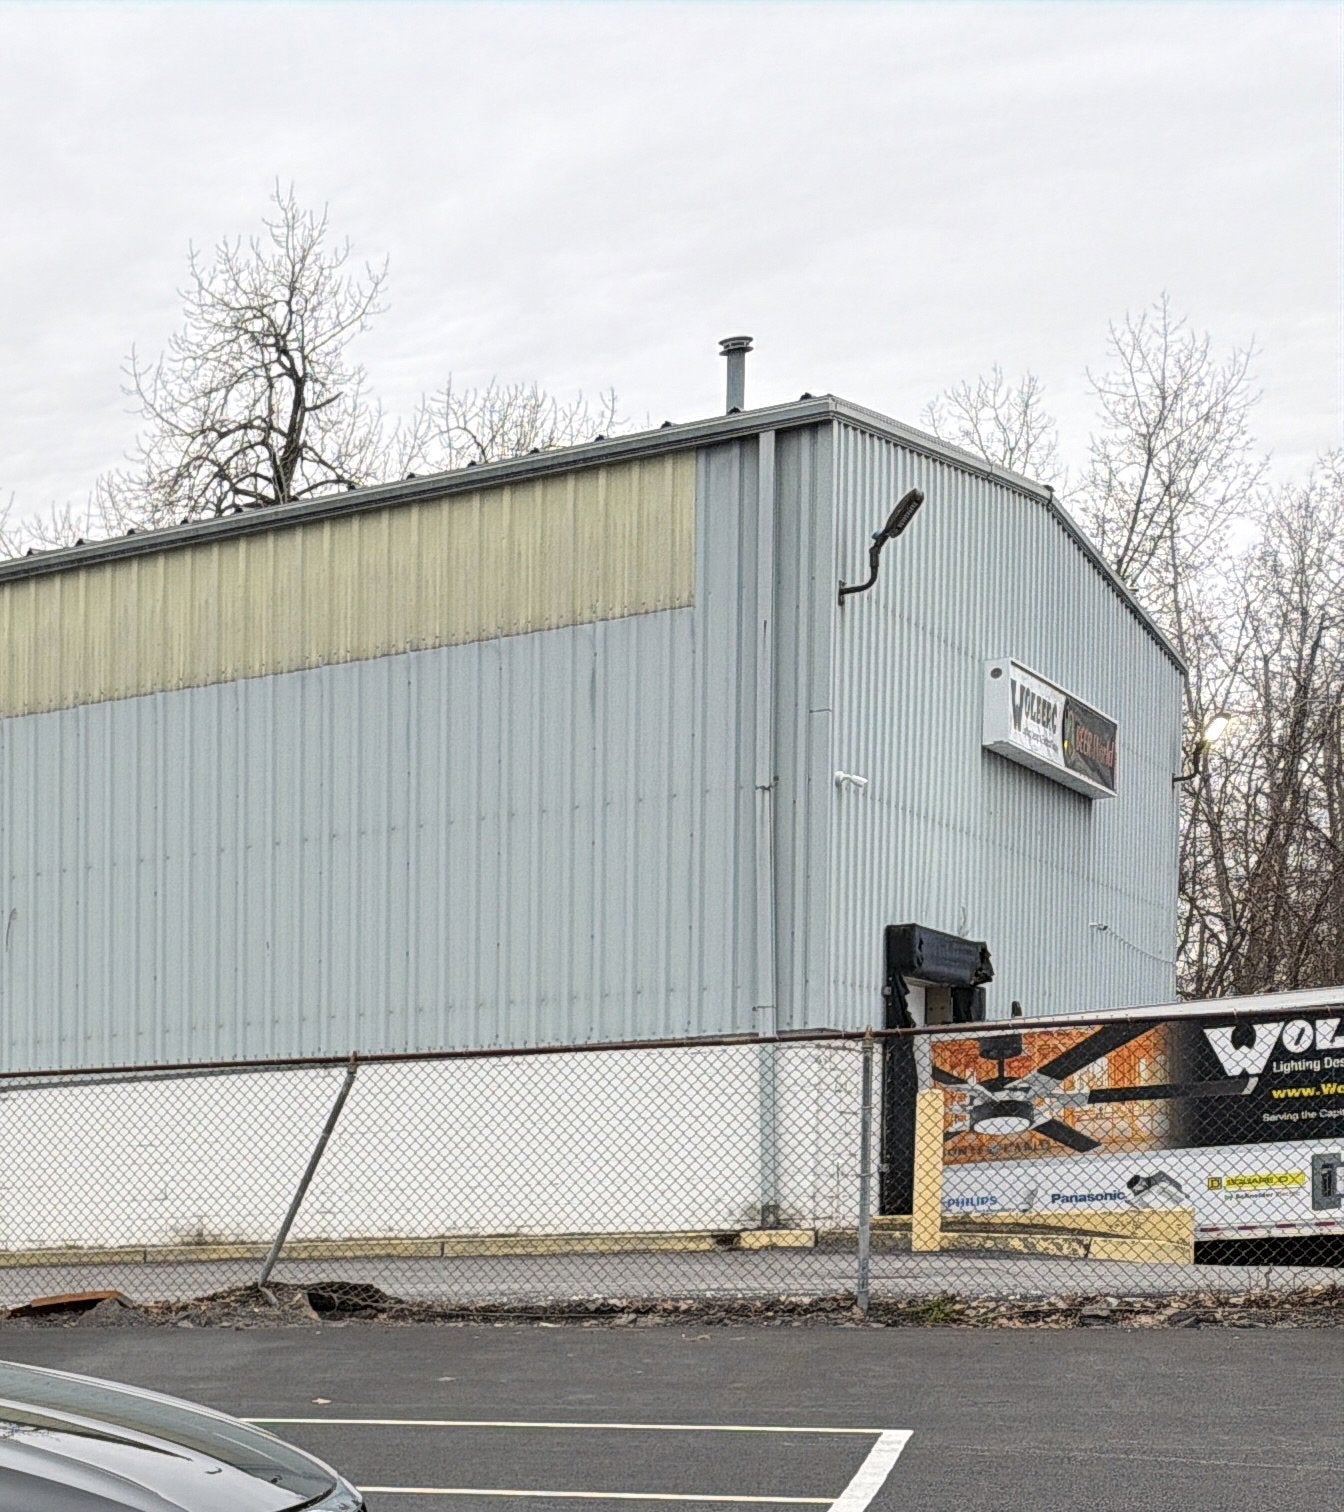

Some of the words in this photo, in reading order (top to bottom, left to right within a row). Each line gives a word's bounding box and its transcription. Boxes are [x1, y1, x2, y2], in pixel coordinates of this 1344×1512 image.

[1010, 678, 1057, 735] WOLBERG
[1273, 1059, 1320, 1074] Lighting
[1263, 1112, 1299, 1122] Serving
[1301, 1110, 1317, 1120] the
[947, 1195, 998, 1208] PHILIPS
[1051, 1190, 1127, 1204] Panasonic
